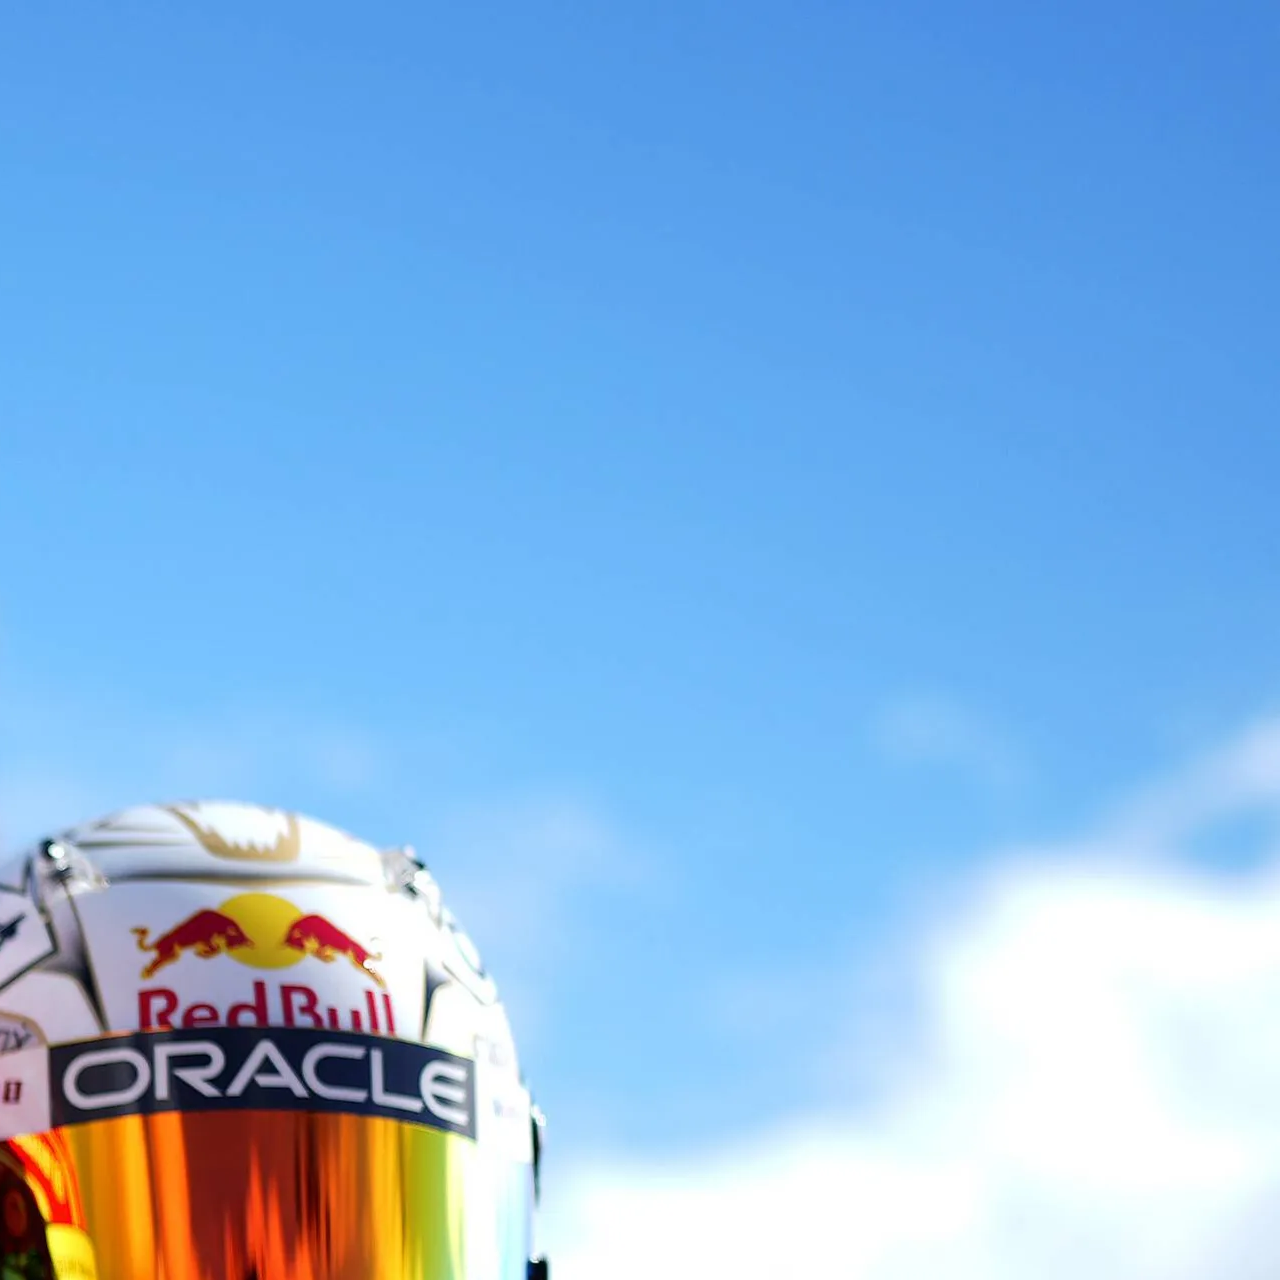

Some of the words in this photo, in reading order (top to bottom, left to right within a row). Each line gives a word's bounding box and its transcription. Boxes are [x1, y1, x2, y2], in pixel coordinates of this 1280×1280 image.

[137, 979, 267, 1032] Red
[282, 983, 395, 1038] Bull
[62, 1039, 470, 1126] ORACLE
